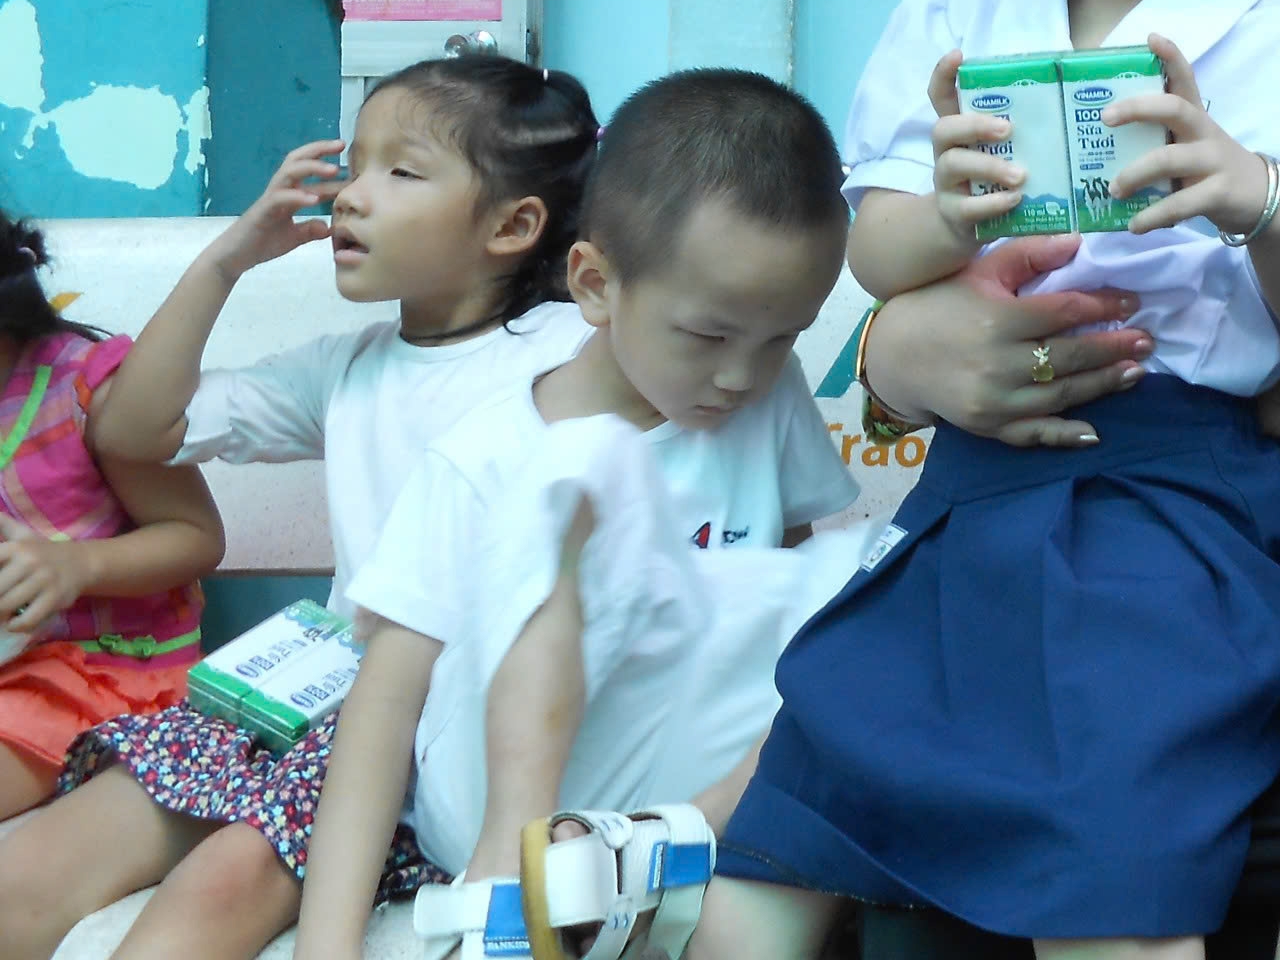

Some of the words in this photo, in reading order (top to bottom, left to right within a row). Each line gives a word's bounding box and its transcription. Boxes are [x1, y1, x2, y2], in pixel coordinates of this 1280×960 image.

[1075, 89, 1113, 100] VINAMILK
[973, 96, 1010, 108] VINAMILK
[1077, 123, 1102, 136] Sữa
[1077, 134, 1115, 150] Tươi
[1023, 208, 1036, 217] 110
